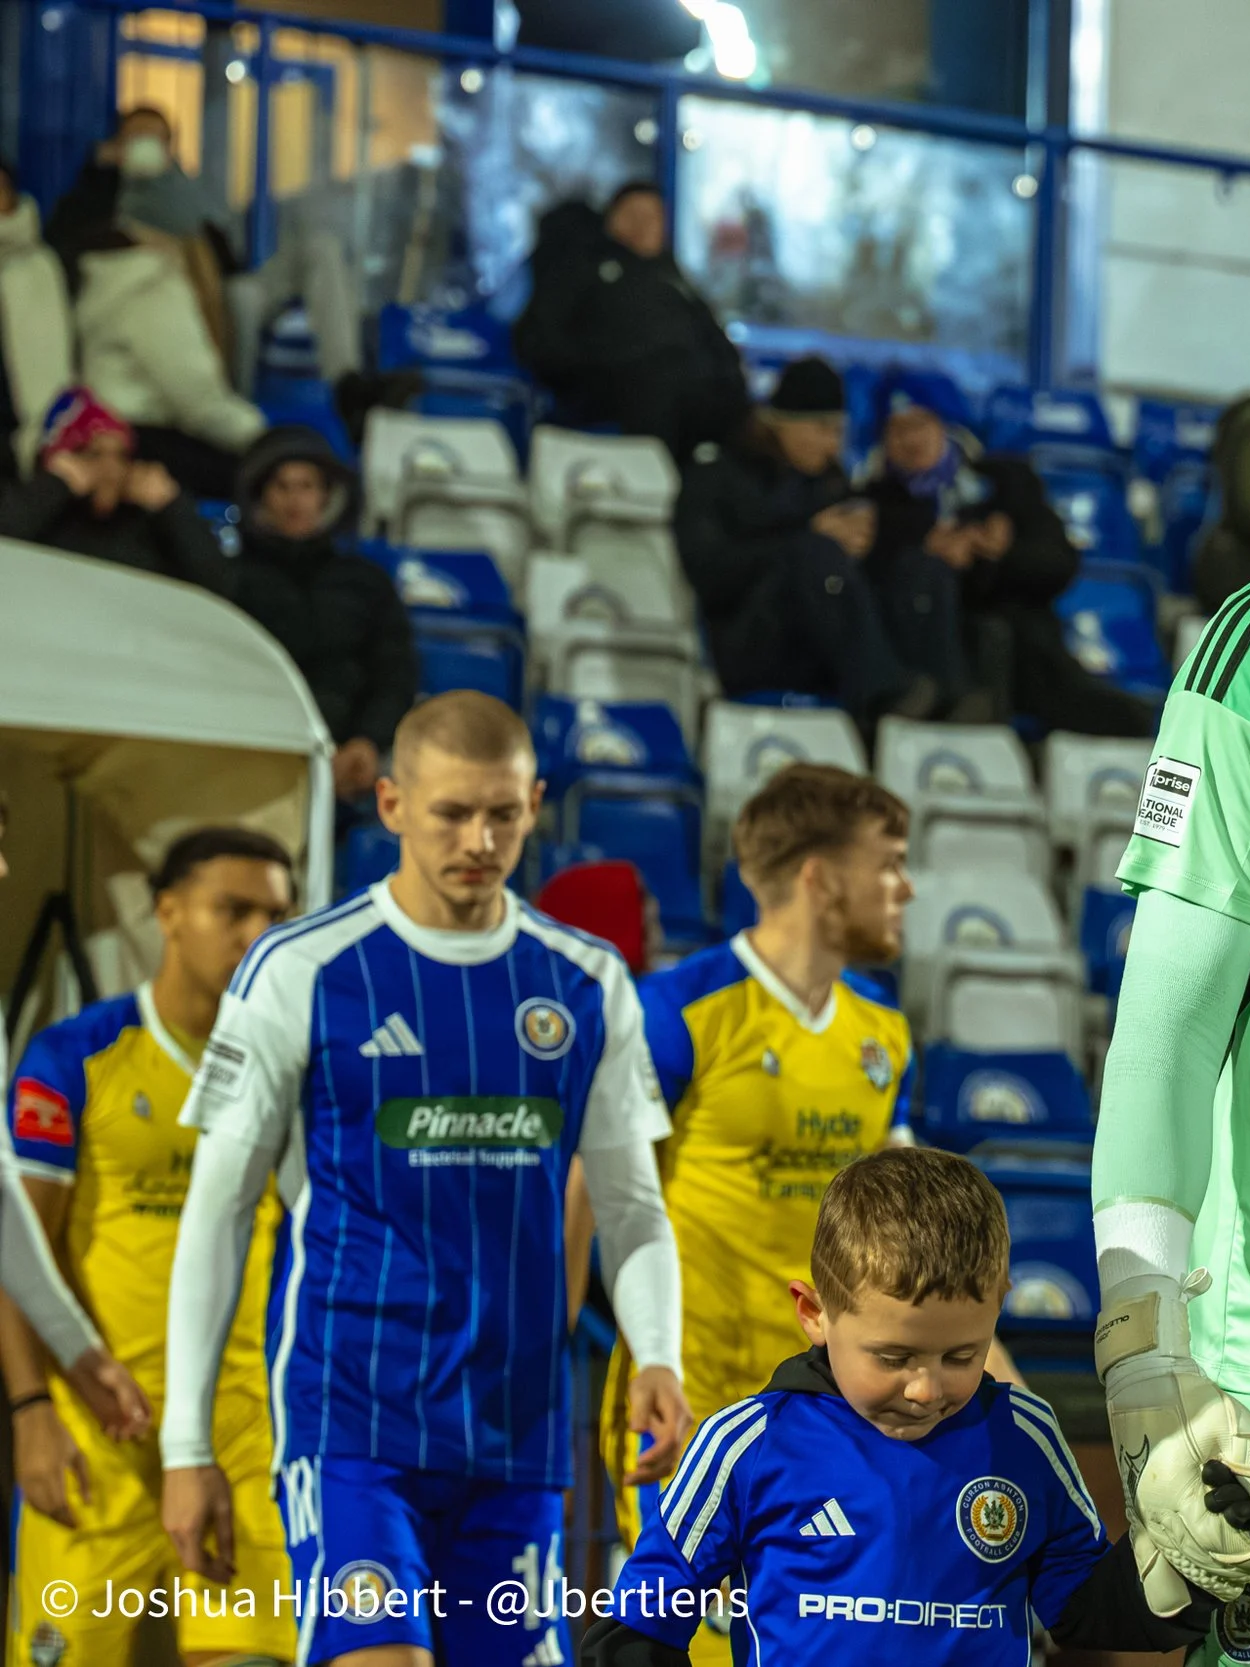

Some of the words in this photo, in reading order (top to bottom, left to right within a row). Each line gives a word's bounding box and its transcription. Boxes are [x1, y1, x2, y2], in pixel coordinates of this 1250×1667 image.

[1143, 798, 1184, 819] TIONAL
[406, 1104, 542, 1140] Pinnacle
[962, 1480, 991, 1509] CURZON
[993, 1481, 1025, 1512] ASHTON
[965, 1527, 1003, 1556] FOOTBALL
[1004, 1530, 1021, 1552] CLUB
[798, 1593, 1007, 1629] PRO:DIRECT
